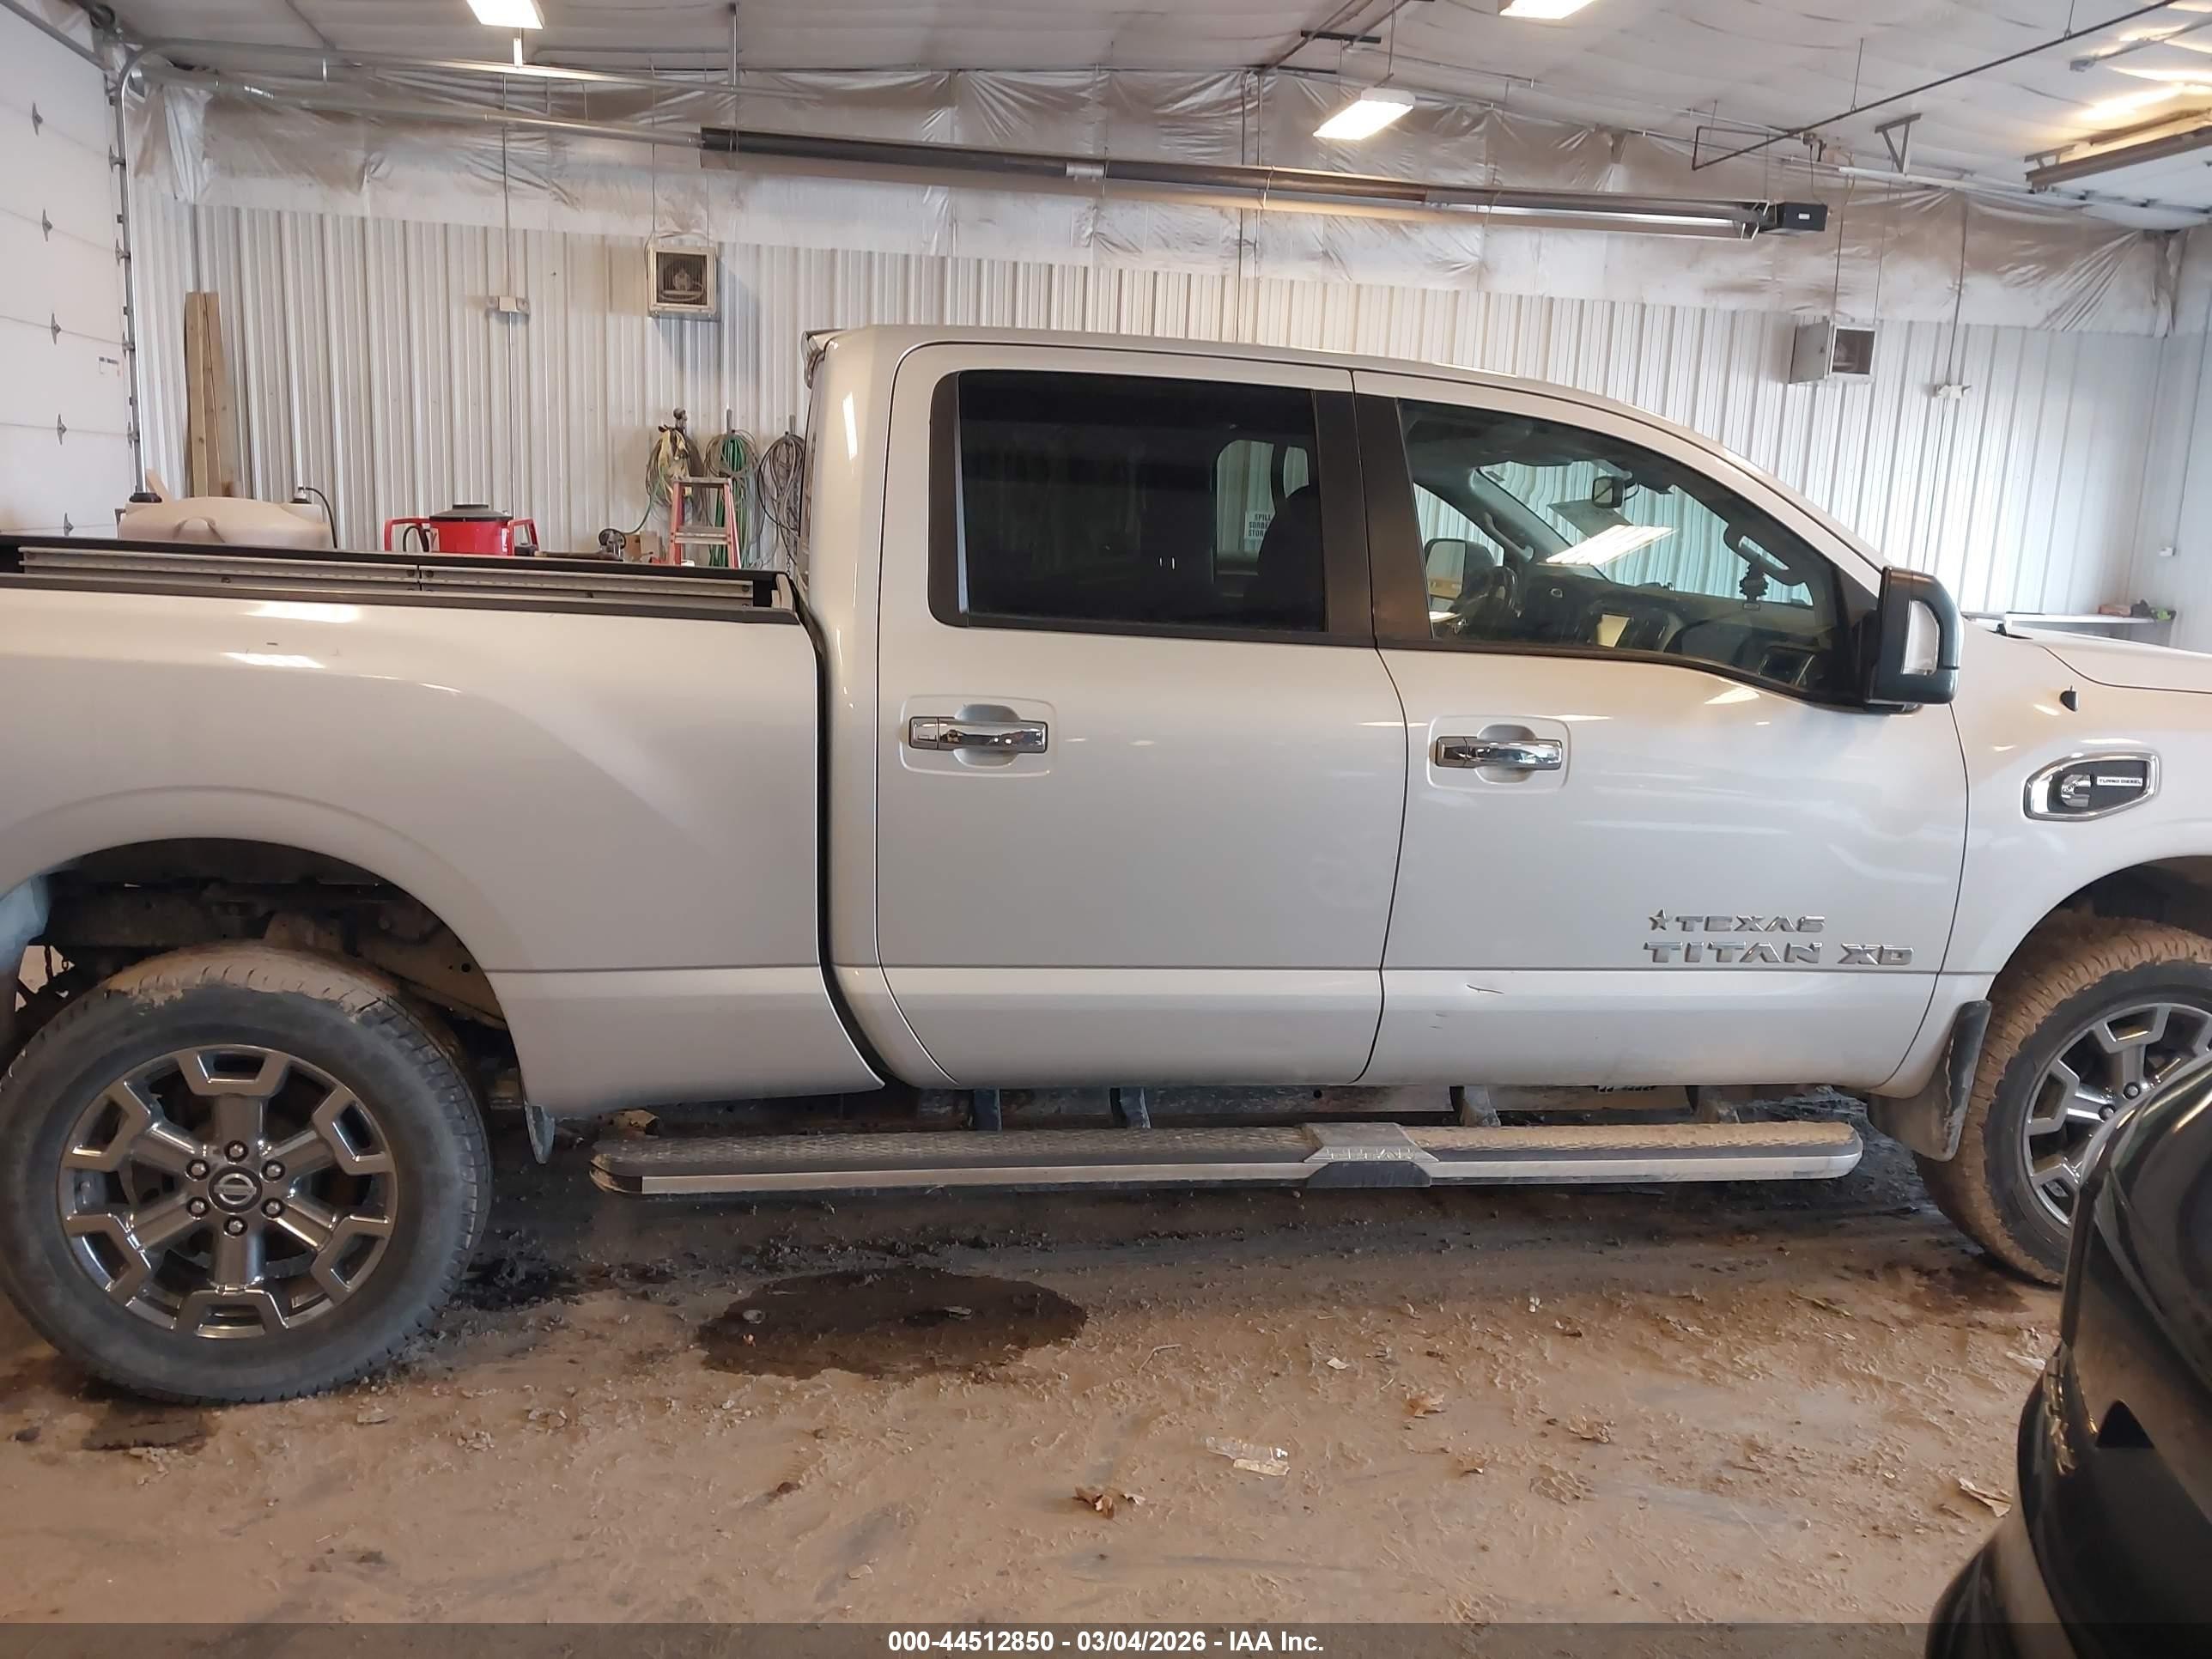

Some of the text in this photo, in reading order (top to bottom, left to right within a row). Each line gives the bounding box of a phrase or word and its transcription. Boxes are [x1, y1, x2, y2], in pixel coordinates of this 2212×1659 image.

[1675, 915, 1826, 933] TEXAS
[1644, 941, 1915, 966] TITAN XD
